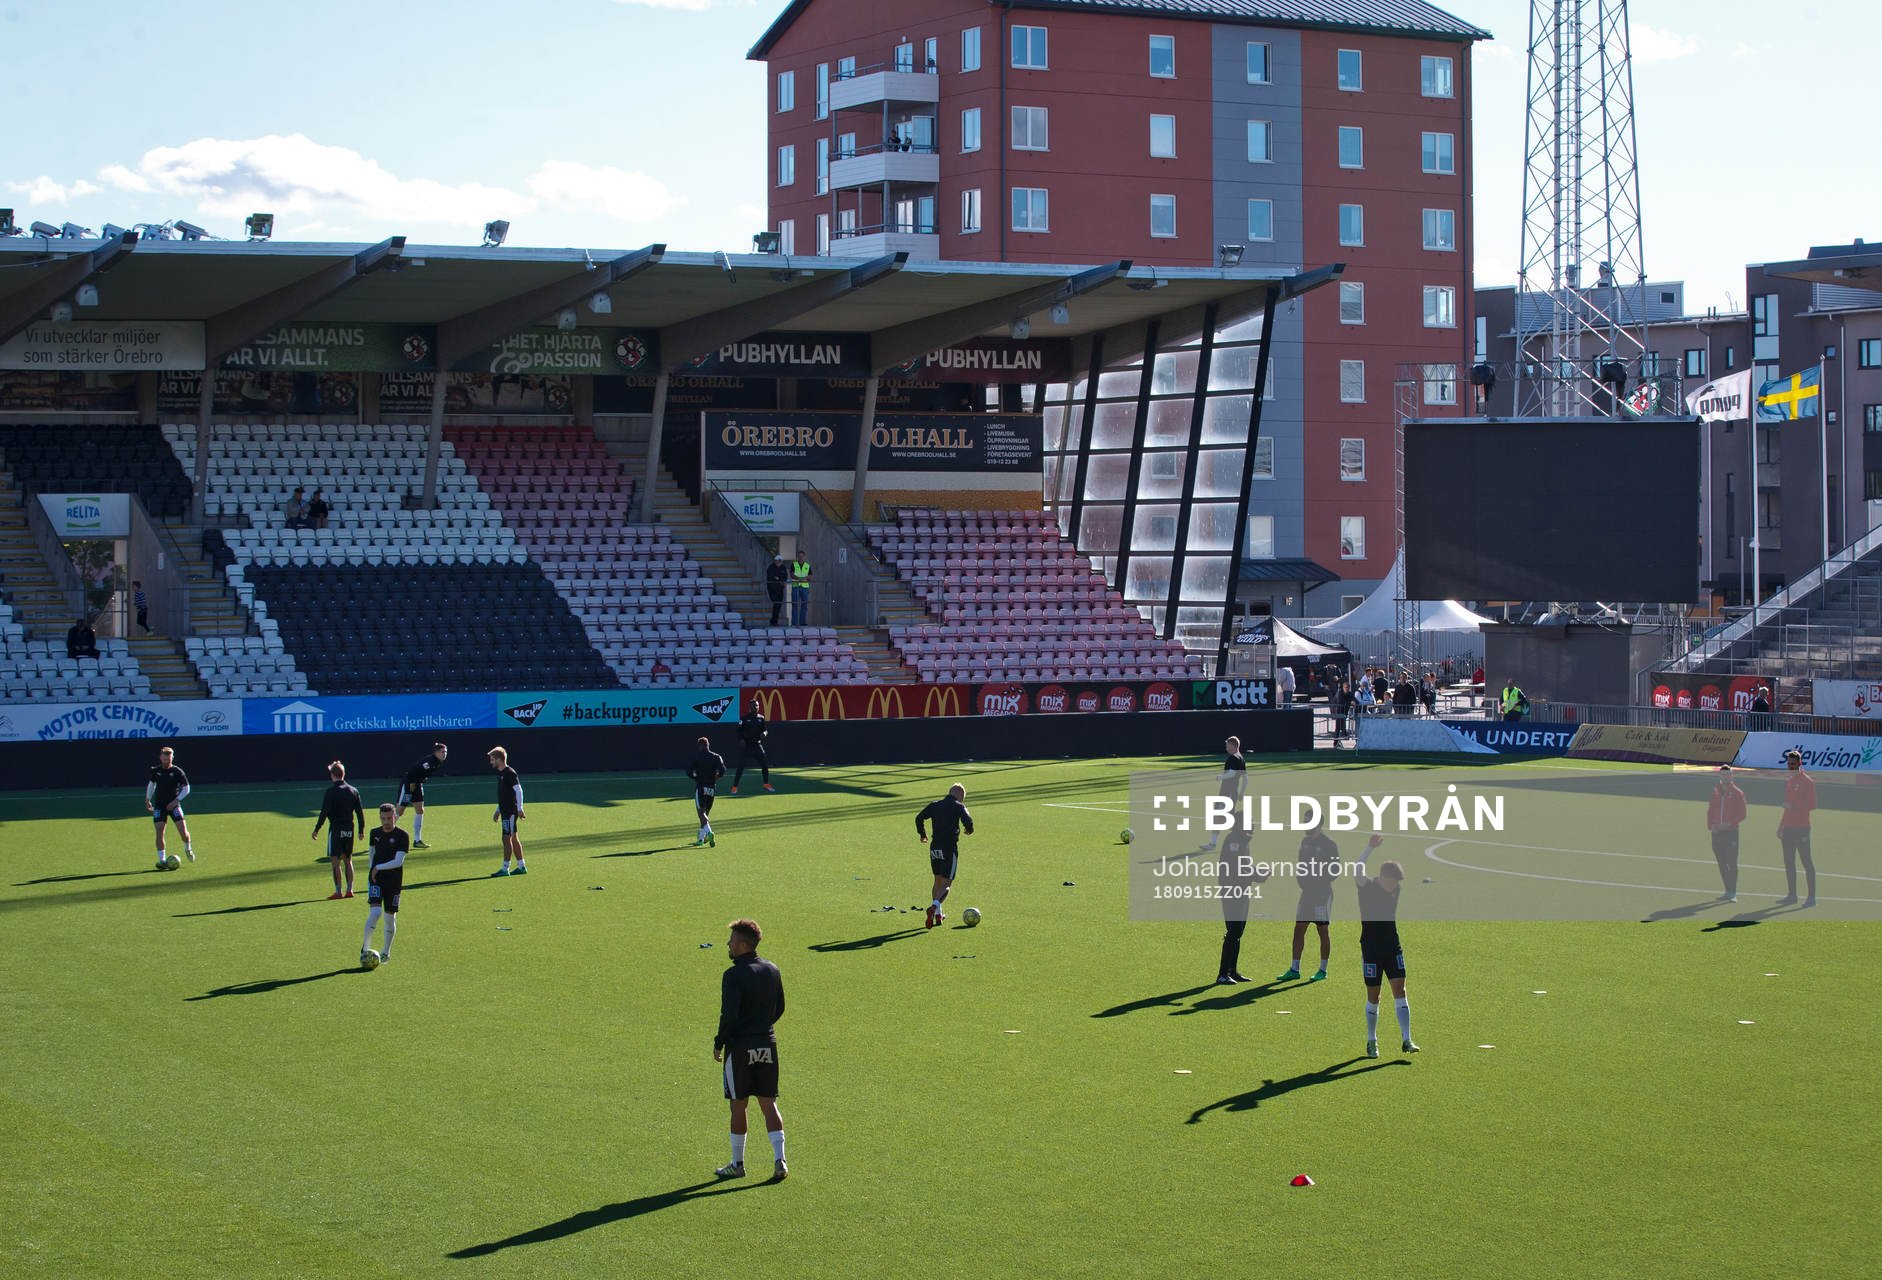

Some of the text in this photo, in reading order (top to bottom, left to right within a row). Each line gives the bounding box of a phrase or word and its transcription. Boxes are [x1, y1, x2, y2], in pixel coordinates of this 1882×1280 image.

[24, 328, 160, 346] Vi utvecklar miljöer
[544, 332, 602, 352] HJÄRTA
[24, 345, 163, 364] som stärker Örebro
[257, 348, 277, 365] VI
[281, 348, 329, 365] ALLT.
[534, 353, 601, 368] PASSION
[719, 343, 841, 365] PUBHYLLAN
[926, 349, 1041, 370] PUBHYLLAN
[180, 381, 194, 394] VI
[401, 384, 415, 397] VI
[721, 420, 974, 449] ÖREBRO ÖLHALL
[66, 506, 100, 519] RELITA
[744, 503, 774, 515] RELITA
[1148, 693, 1173, 706] mix
[1216, 680, 1268, 706] Rätt
[1655, 694, 1669, 704] mix
[984, 694, 1020, 712] mix
[1041, 695, 1064, 707] mix
[1079, 698, 1096, 707] mix
[1110, 696, 1132, 707] mix
[1678, 696, 1691, 704] mix
[1701, 695, 1719, 708] mix
[513, 709, 536, 718] BACK
[562, 702, 678, 723] #backupgroup
[702, 705, 723, 714] BACK
[38, 705, 180, 740] MOTOR CENTRUM
[334, 714, 473, 731] Grekiska kolgrillsbaren
[1692, 733, 1733, 745] Konditori
